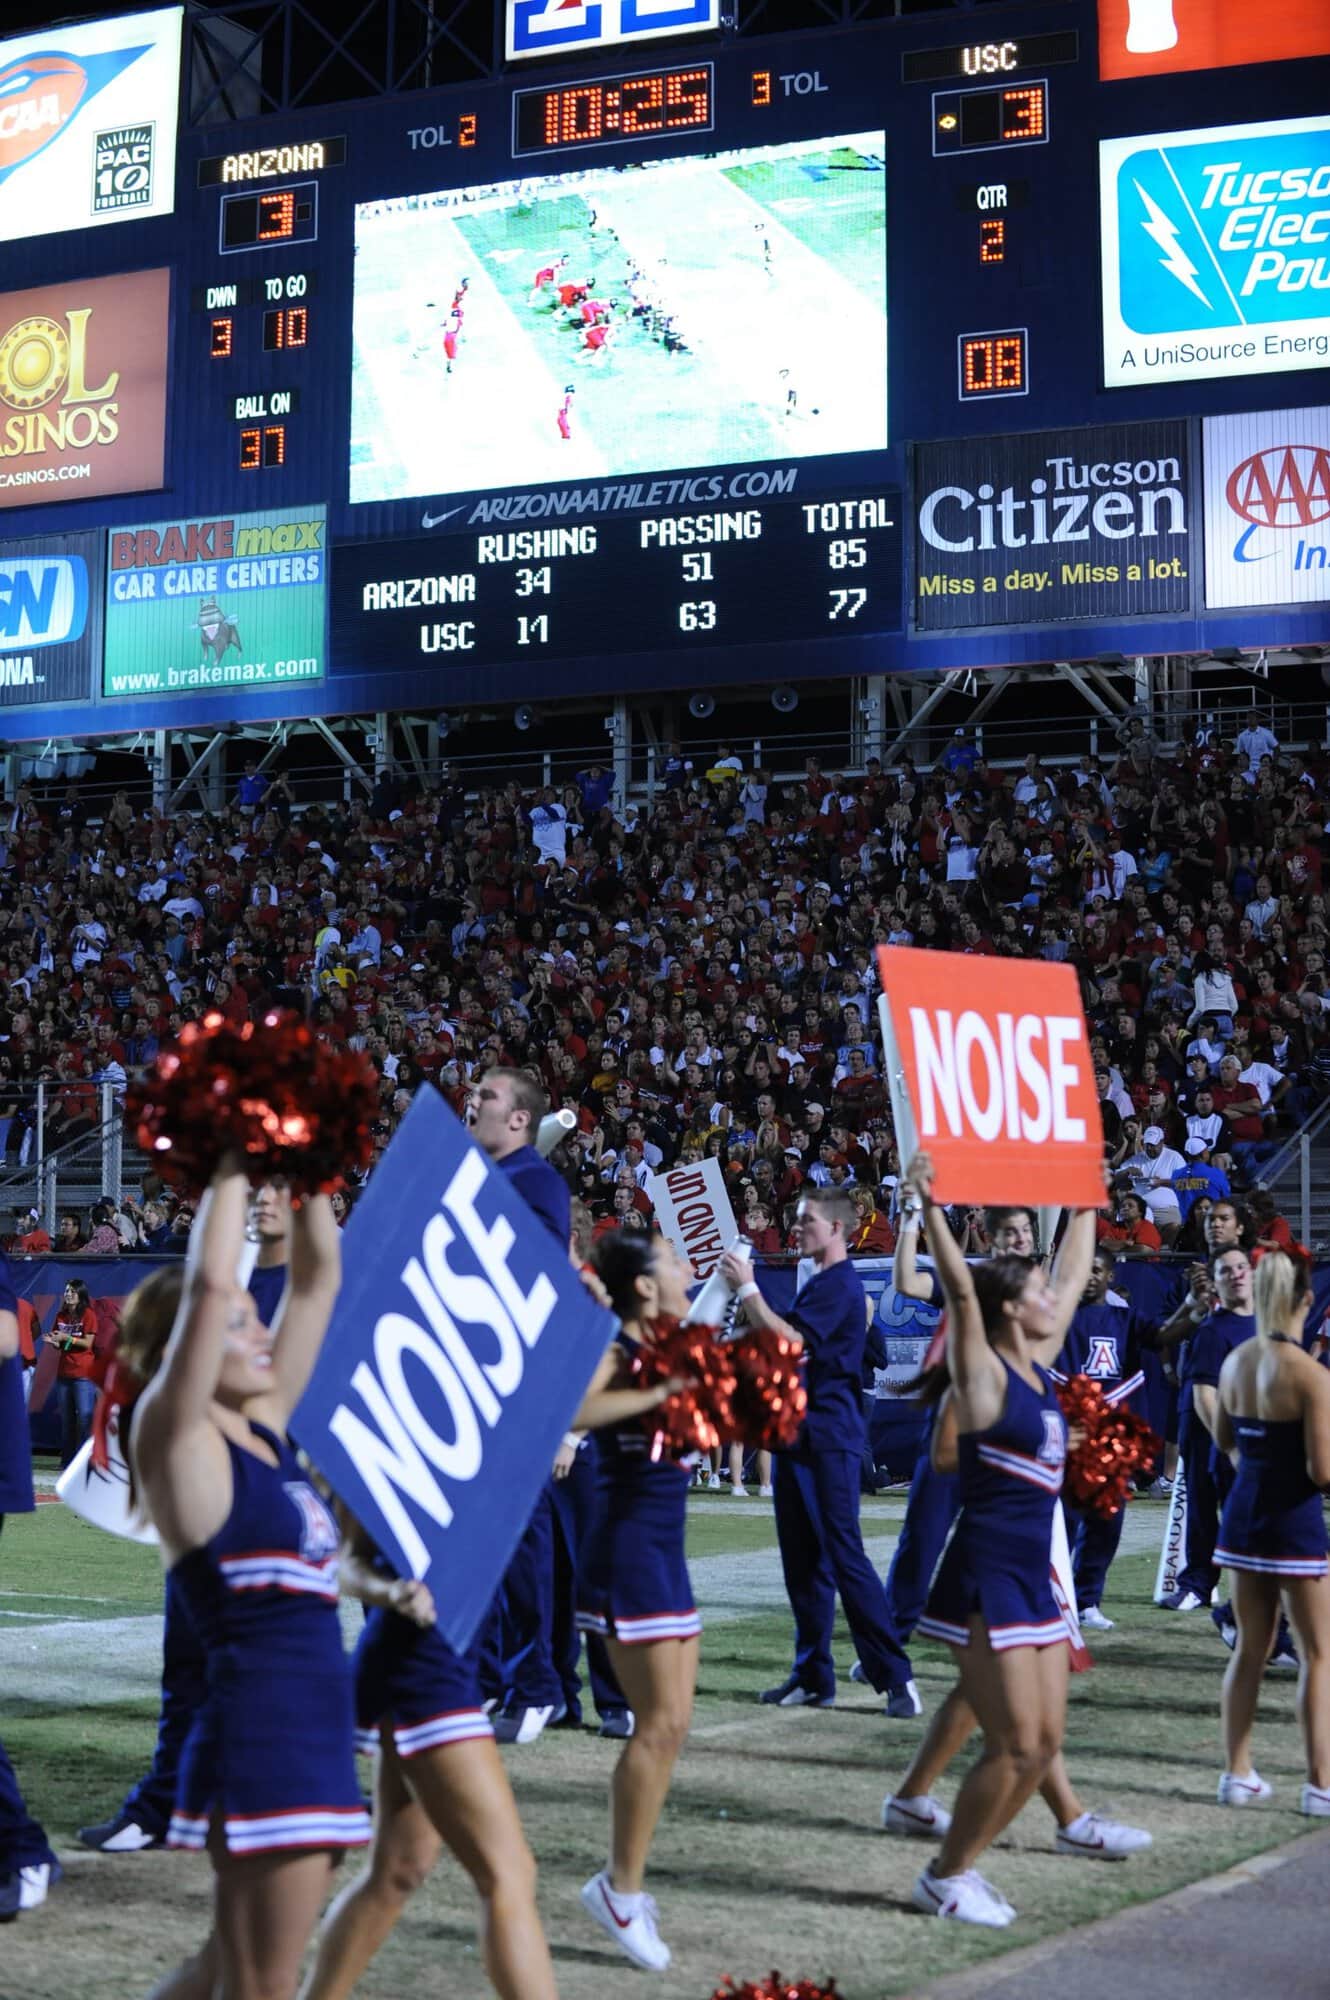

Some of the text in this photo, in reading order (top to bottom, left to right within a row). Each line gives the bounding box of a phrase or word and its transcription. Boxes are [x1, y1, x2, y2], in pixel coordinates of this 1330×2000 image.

[963, 42, 1017, 75] USC
[545, 71, 707, 144] 10:25
[752, 71, 828, 105] 3 TOL
[408, 114, 476, 150] TOL 2
[1003, 88, 1043, 139] 3
[97, 144, 150, 169] PAC
[222, 142, 324, 183] ARIZONA
[96, 190, 148, 209] FOOTBALL
[97, 165, 149, 195] 10
[976, 184, 1007, 209] QTR
[258, 193, 294, 240] 3
[1218, 204, 1330, 251] Elec
[980, 220, 1004, 262] 2
[206, 285, 237, 309] DWN
[265, 274, 307, 300] TO GO
[211, 319, 232, 357] 3
[275, 308, 307, 349] 10
[965, 336, 1021, 391] 08
[1120, 350, 1136, 369] A
[1144, 342, 1256, 368] UniSource
[235, 392, 291, 420] BALL ON
[0, 403, 119, 457] SINOS
[241, 427, 284, 468] 37
[1046, 456, 1181, 491] Tucson
[1238, 446, 1330, 527] AAA
[468, 468, 798, 525] ARIZONAATHLETICS.COM
[919, 478, 1187, 553] Citizen
[111, 520, 325, 571] BRAKE max
[478, 499, 893, 564] RUSHING PASSING TOTAL
[363, 539, 867, 611] ARIZONA 34 51 85
[1294, 541, 1330, 570] In
[113, 554, 320, 601] CAR CARE CENTERS
[919, 557, 1187, 597] Miss a day. Miss a lot.
[421, 621, 475, 654] USC
[679, 600, 716, 631] 63
[829, 588, 867, 620] 77
[111, 657, 318, 691] www.brakemax.com
[909, 1007, 1086, 1144] NOISE
[666, 1171, 724, 1281] STAND UP
[329, 1147, 558, 1580] NOISE
[1082, 1337, 1122, 1379] A
